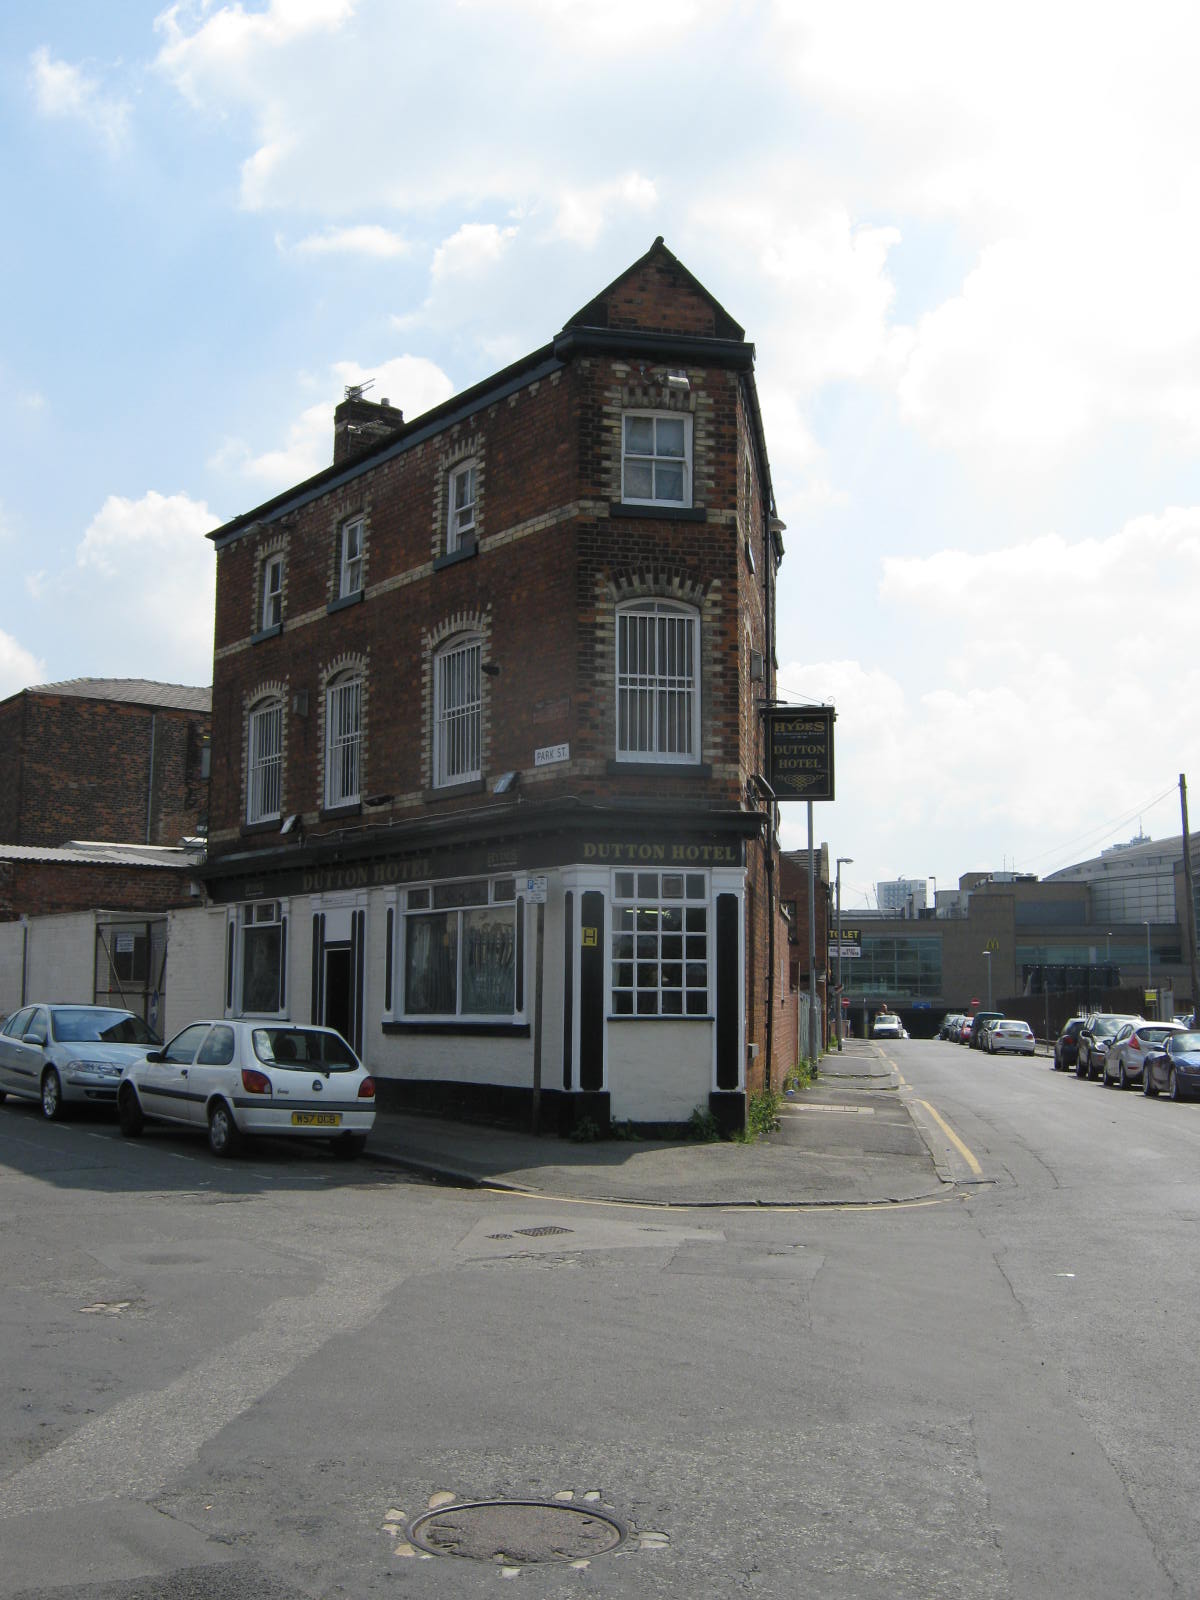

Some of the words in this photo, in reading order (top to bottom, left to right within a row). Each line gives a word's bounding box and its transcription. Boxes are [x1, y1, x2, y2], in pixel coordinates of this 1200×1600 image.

[774, 719, 825, 732] HYDES
[536, 749, 554, 762] PARK
[774, 745, 825, 755] DUTTON
[779, 759, 821, 769] HOTEL
[583, 842, 665, 858] DUTTON
[672, 844, 736, 861] HOTEL
[303, 866, 369, 891] DUTTON
[373, 859, 433, 881] HOTEL
[583, 928, 596, 944] H
[842, 930, 860, 939] LET
